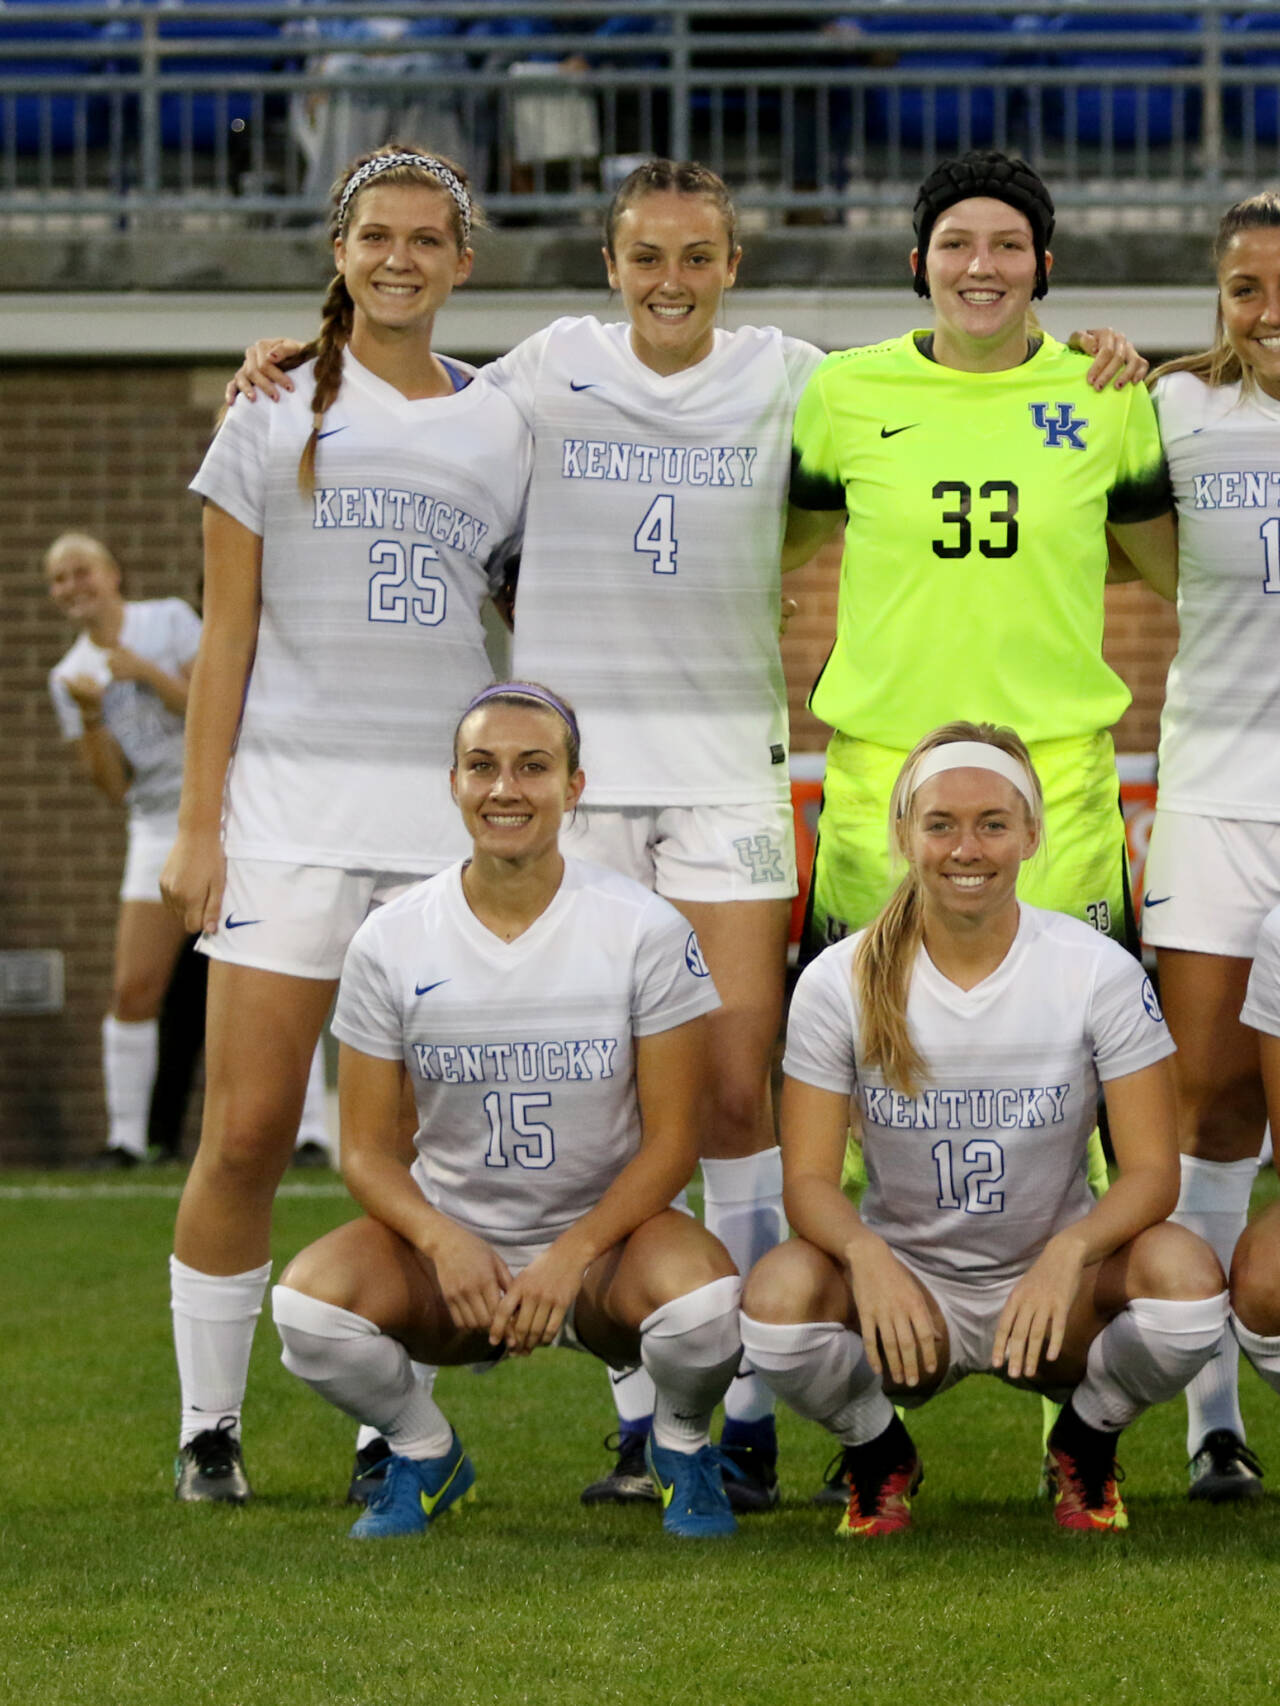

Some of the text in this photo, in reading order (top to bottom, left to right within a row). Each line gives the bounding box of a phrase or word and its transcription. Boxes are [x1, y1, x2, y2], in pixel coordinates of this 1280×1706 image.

[1028, 402, 1089, 450] UK
[562, 439, 757, 487] KENTUCKY
[312, 488, 489, 558] KENTUCKY
[634, 494, 678, 575] 4
[932, 480, 1019, 559] 33
[368, 540, 447, 627] 25
[732, 835, 786, 884] UK
[1086, 900, 1111, 932] 33
[412, 1039, 618, 1083] KENTUCKY
[483, 1091, 556, 1169] 15
[863, 1083, 1070, 1129] KENTUCKY
[932, 1139, 1005, 1214] 12
